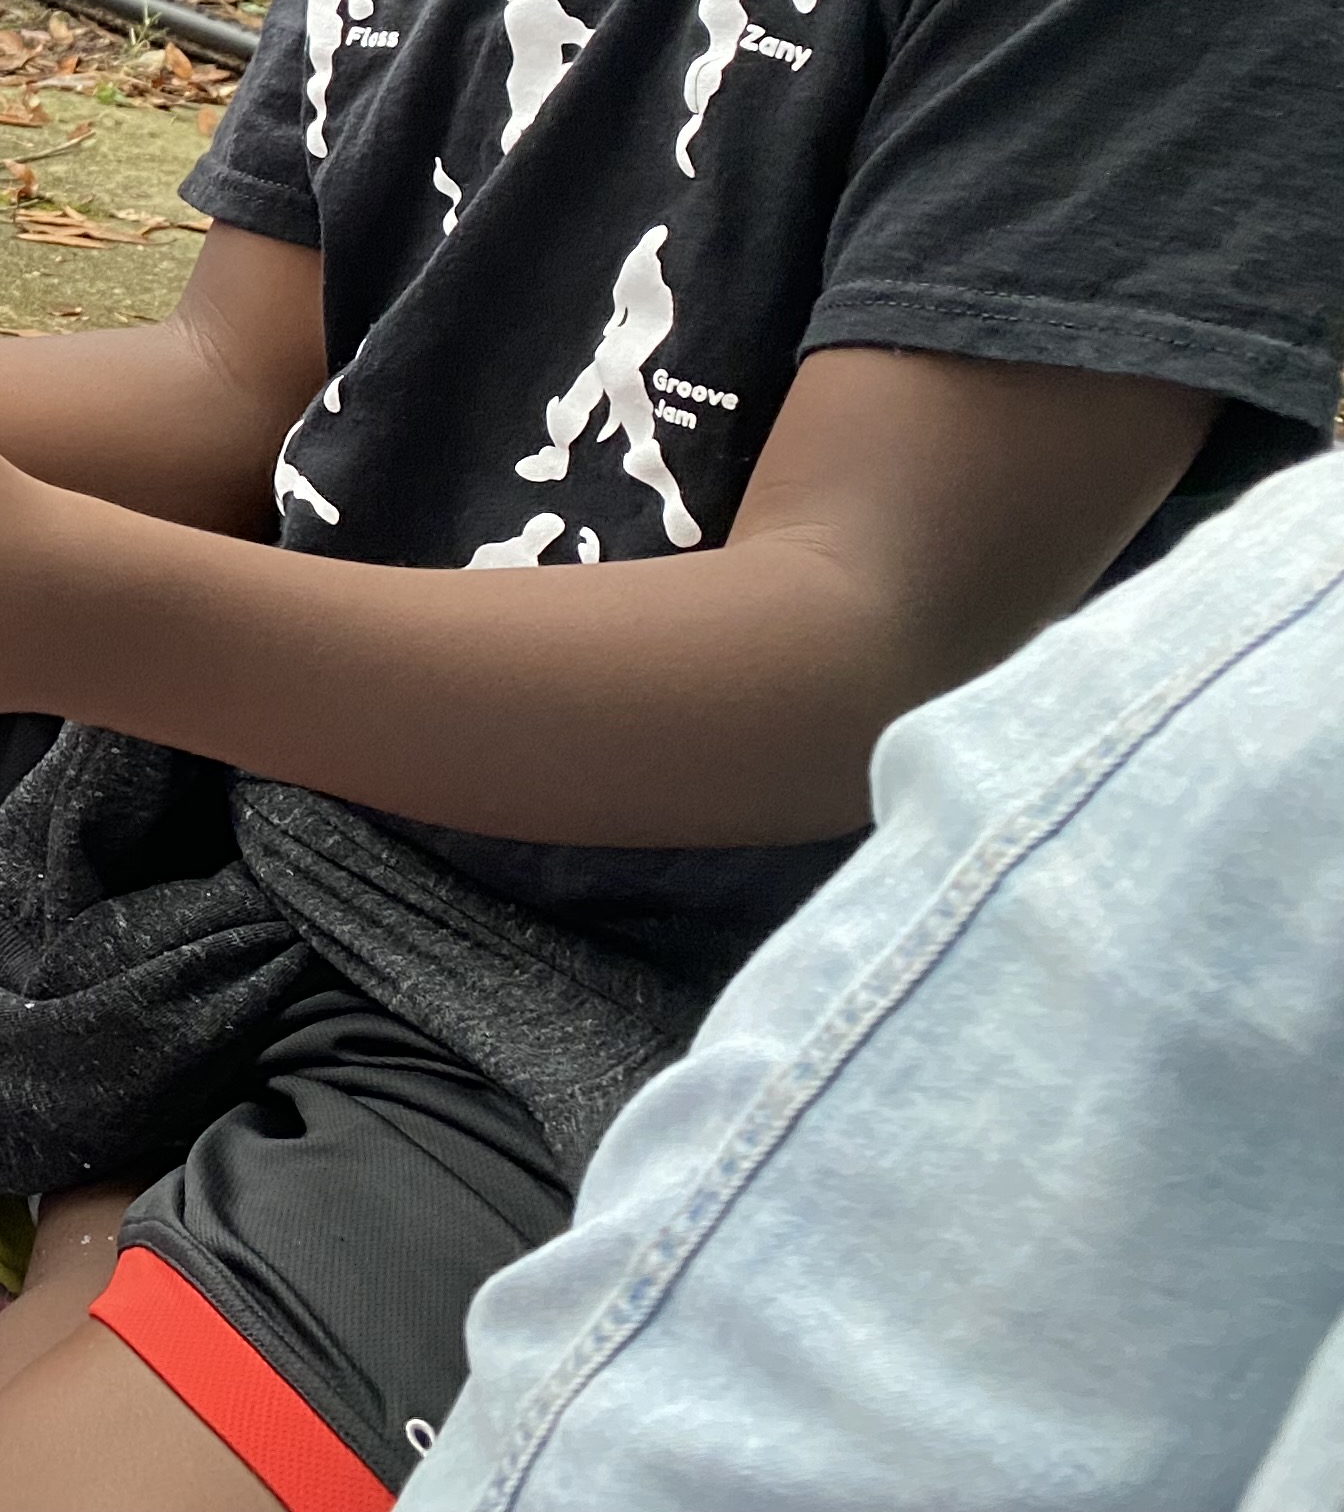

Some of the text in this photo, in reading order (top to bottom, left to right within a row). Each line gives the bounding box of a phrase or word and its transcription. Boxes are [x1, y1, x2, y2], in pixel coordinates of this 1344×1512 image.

[345, 26, 400, 48] Floss
[739, 23, 813, 72] Zany
[653, 368, 739, 411] Groove
[654, 398, 697, 430] Jam
